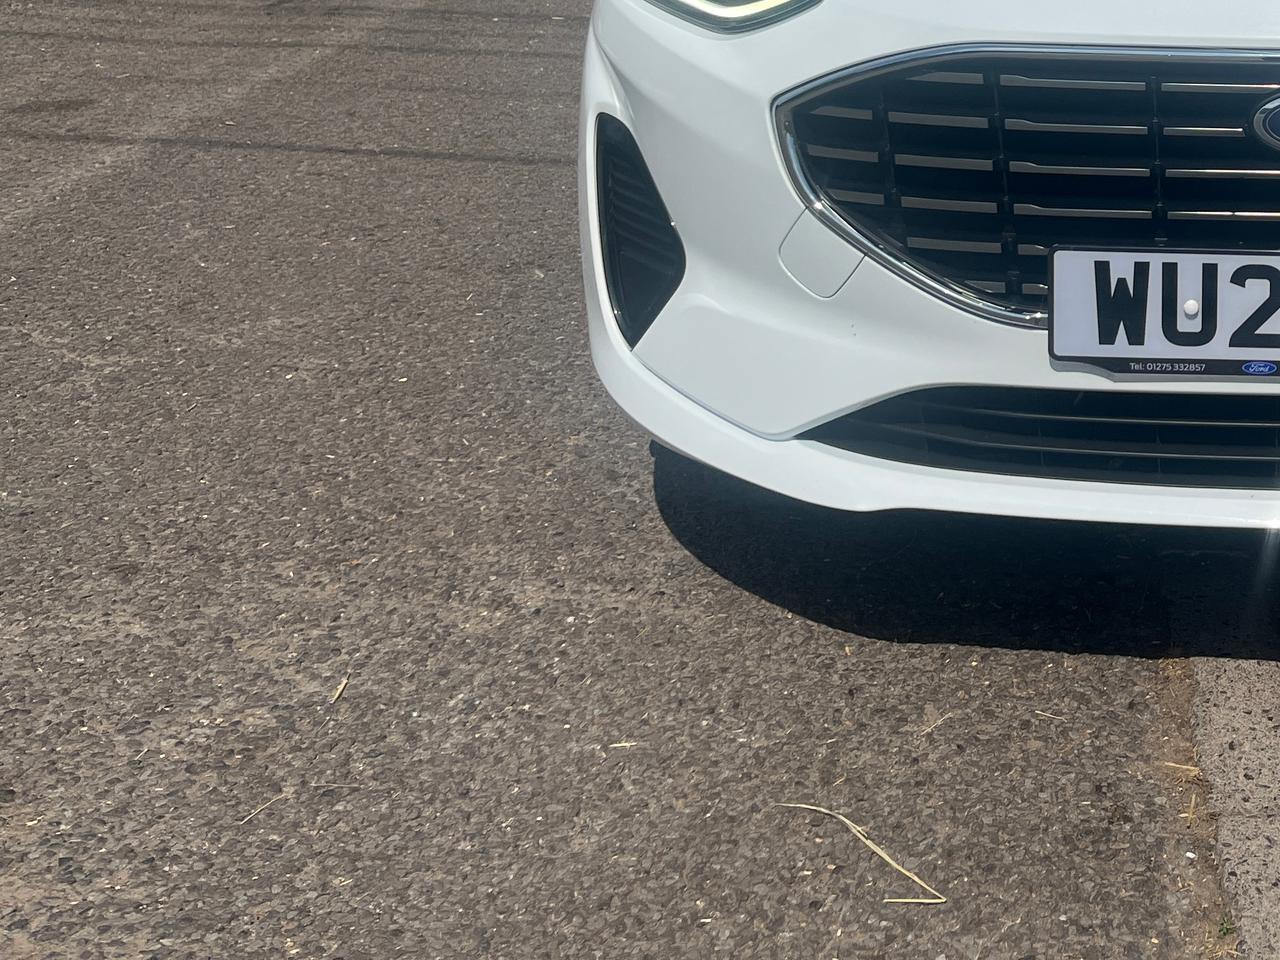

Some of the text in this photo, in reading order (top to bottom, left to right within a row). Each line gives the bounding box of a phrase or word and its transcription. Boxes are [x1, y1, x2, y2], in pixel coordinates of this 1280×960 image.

[1129, 362, 1206, 372] Tel: 01275 332857
